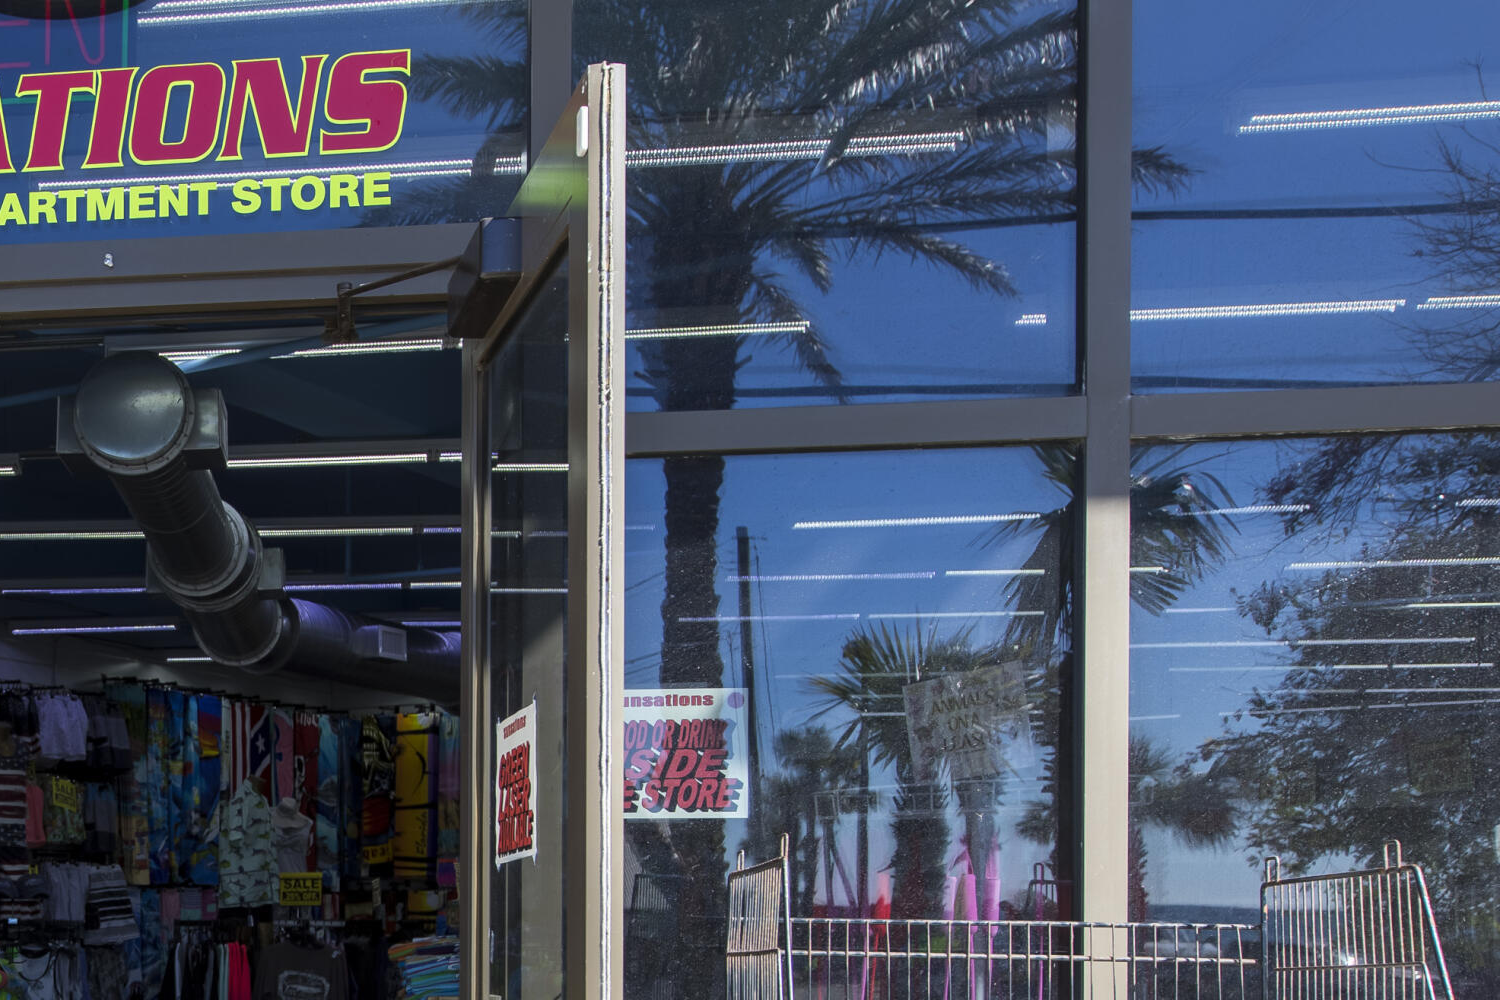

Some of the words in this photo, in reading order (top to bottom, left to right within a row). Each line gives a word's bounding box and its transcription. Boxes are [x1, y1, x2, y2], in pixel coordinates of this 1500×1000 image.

[232, 171, 392, 213] STORE
[623, 694, 714, 708] nsations
[651, 719, 676, 750] OR
[677, 718, 729, 750] DRINK
[498, 741, 531, 790] GREEN
[623, 748, 728, 779] SIDE
[498, 777, 532, 823] LASER
[641, 778, 738, 810] STORE
[283, 878, 320, 890] SALE
